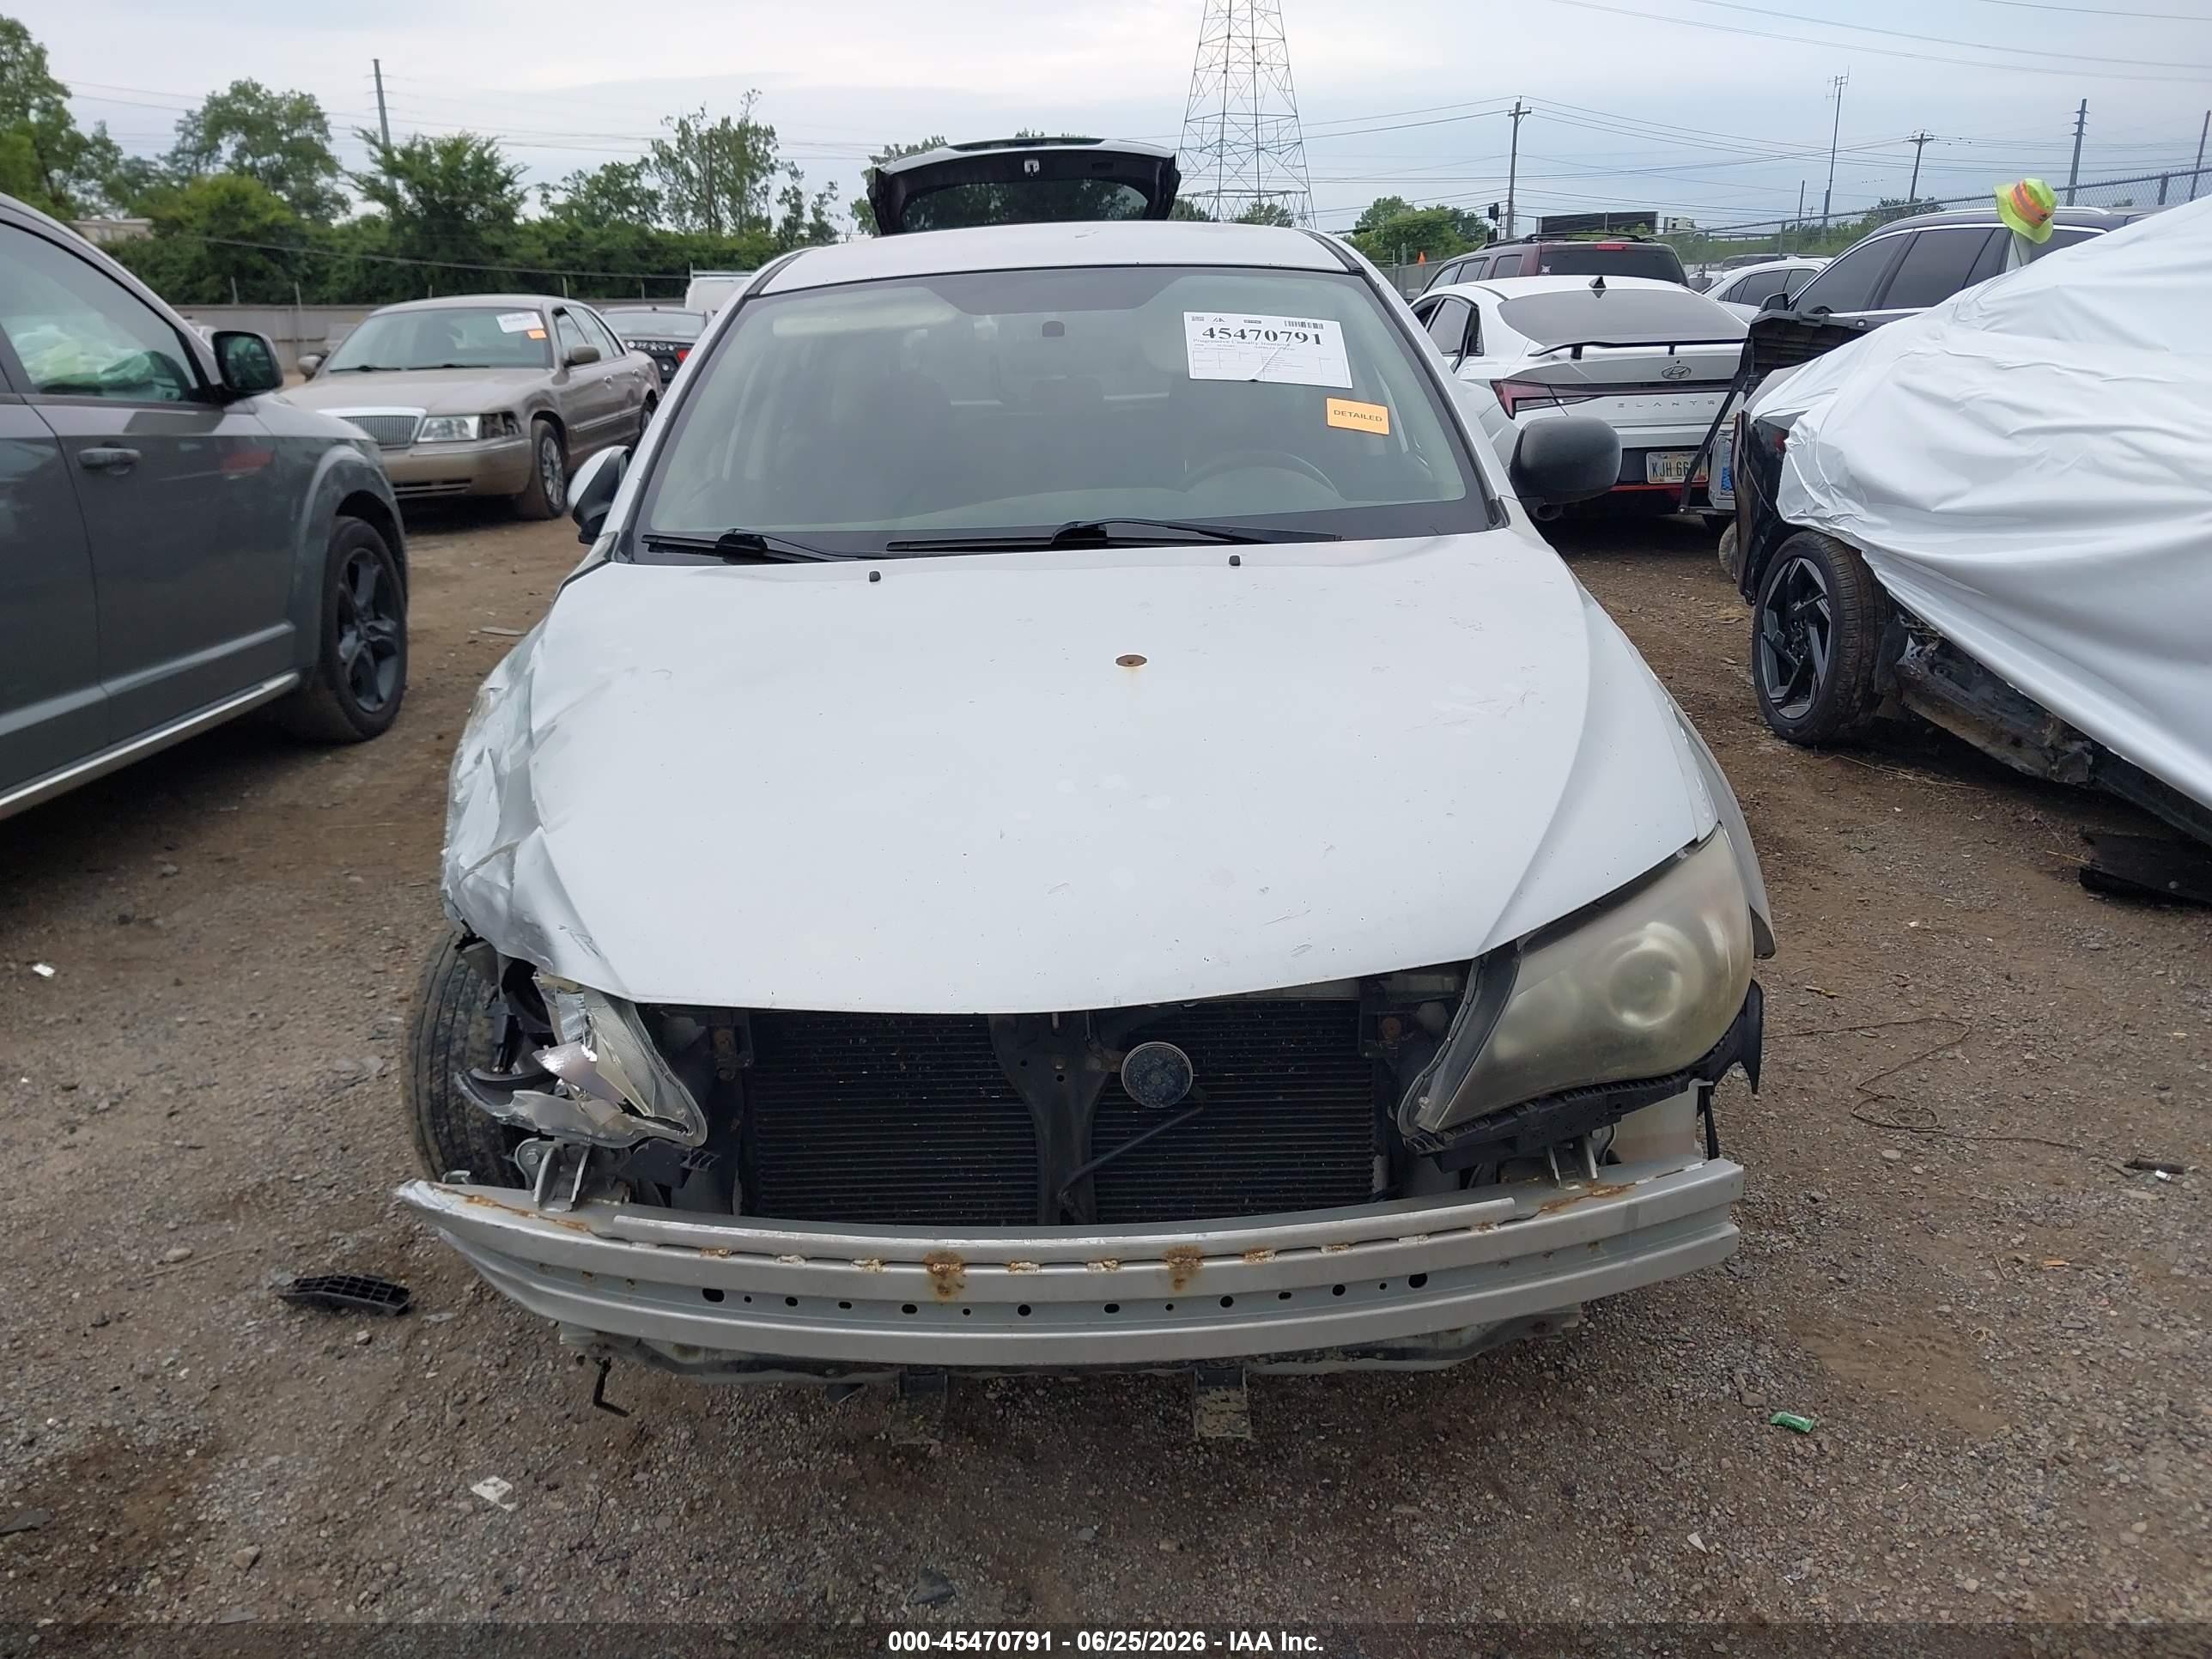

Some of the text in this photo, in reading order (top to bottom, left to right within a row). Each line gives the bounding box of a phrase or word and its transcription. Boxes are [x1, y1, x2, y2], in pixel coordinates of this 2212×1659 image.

[1201, 326, 1324, 345] 45470791
[1617, 399, 1716, 409] ELANTR
[1333, 409, 1383, 422] DETAILED
[1651, 461, 1702, 477] KJH 66
